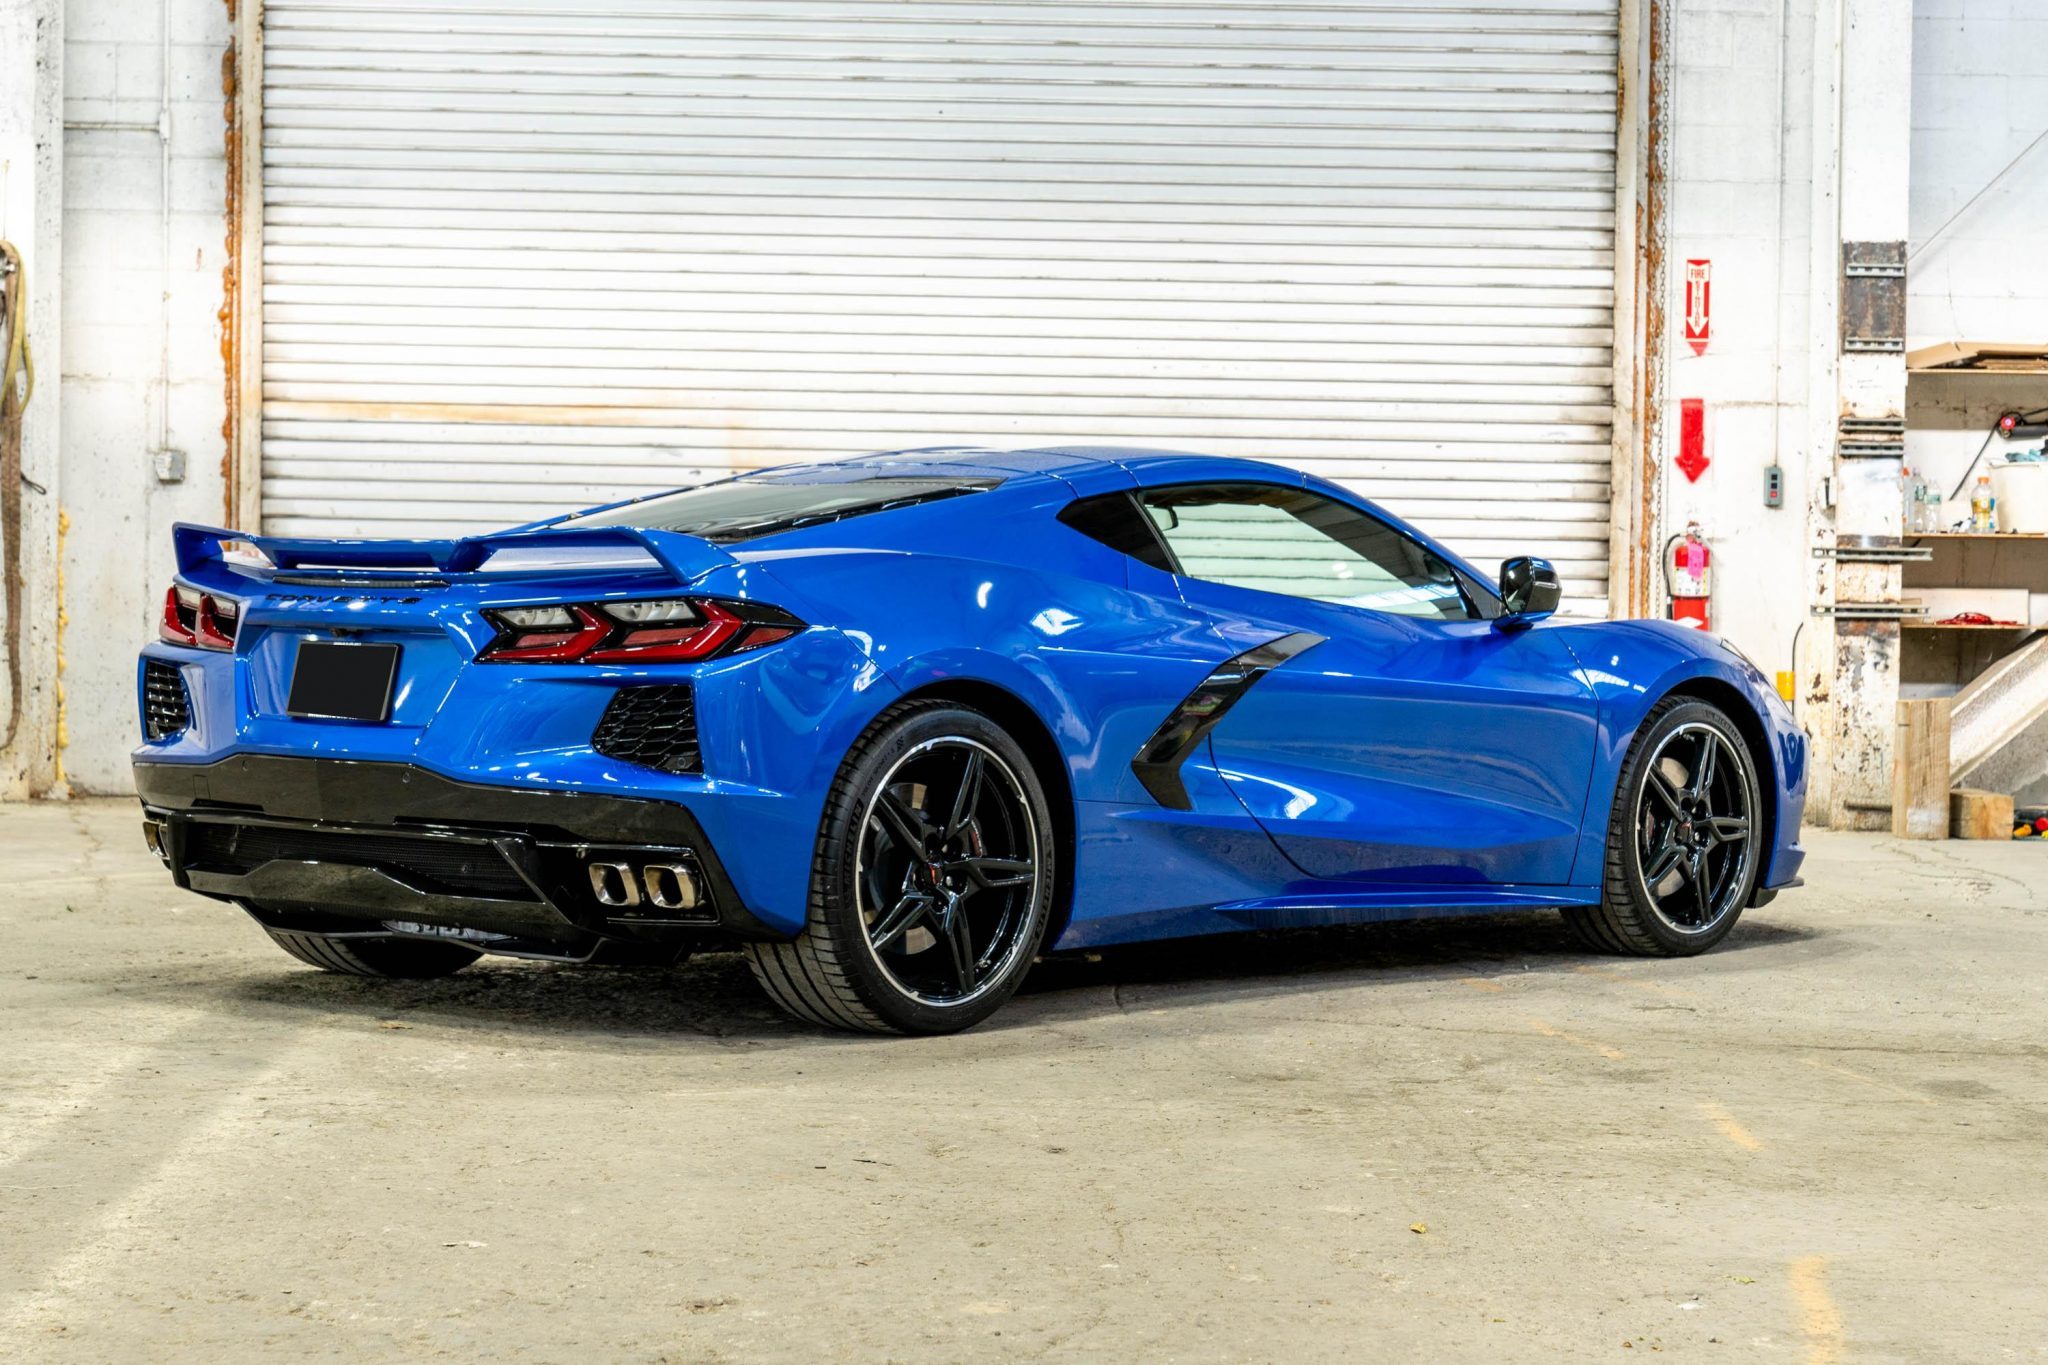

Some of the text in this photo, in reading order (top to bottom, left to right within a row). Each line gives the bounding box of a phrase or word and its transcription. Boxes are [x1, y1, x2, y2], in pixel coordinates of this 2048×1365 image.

[1690, 268, 1704, 279] FIRE
[265, 593, 423, 604] CORVETTE
[843, 803, 863, 885] MICHELIN
